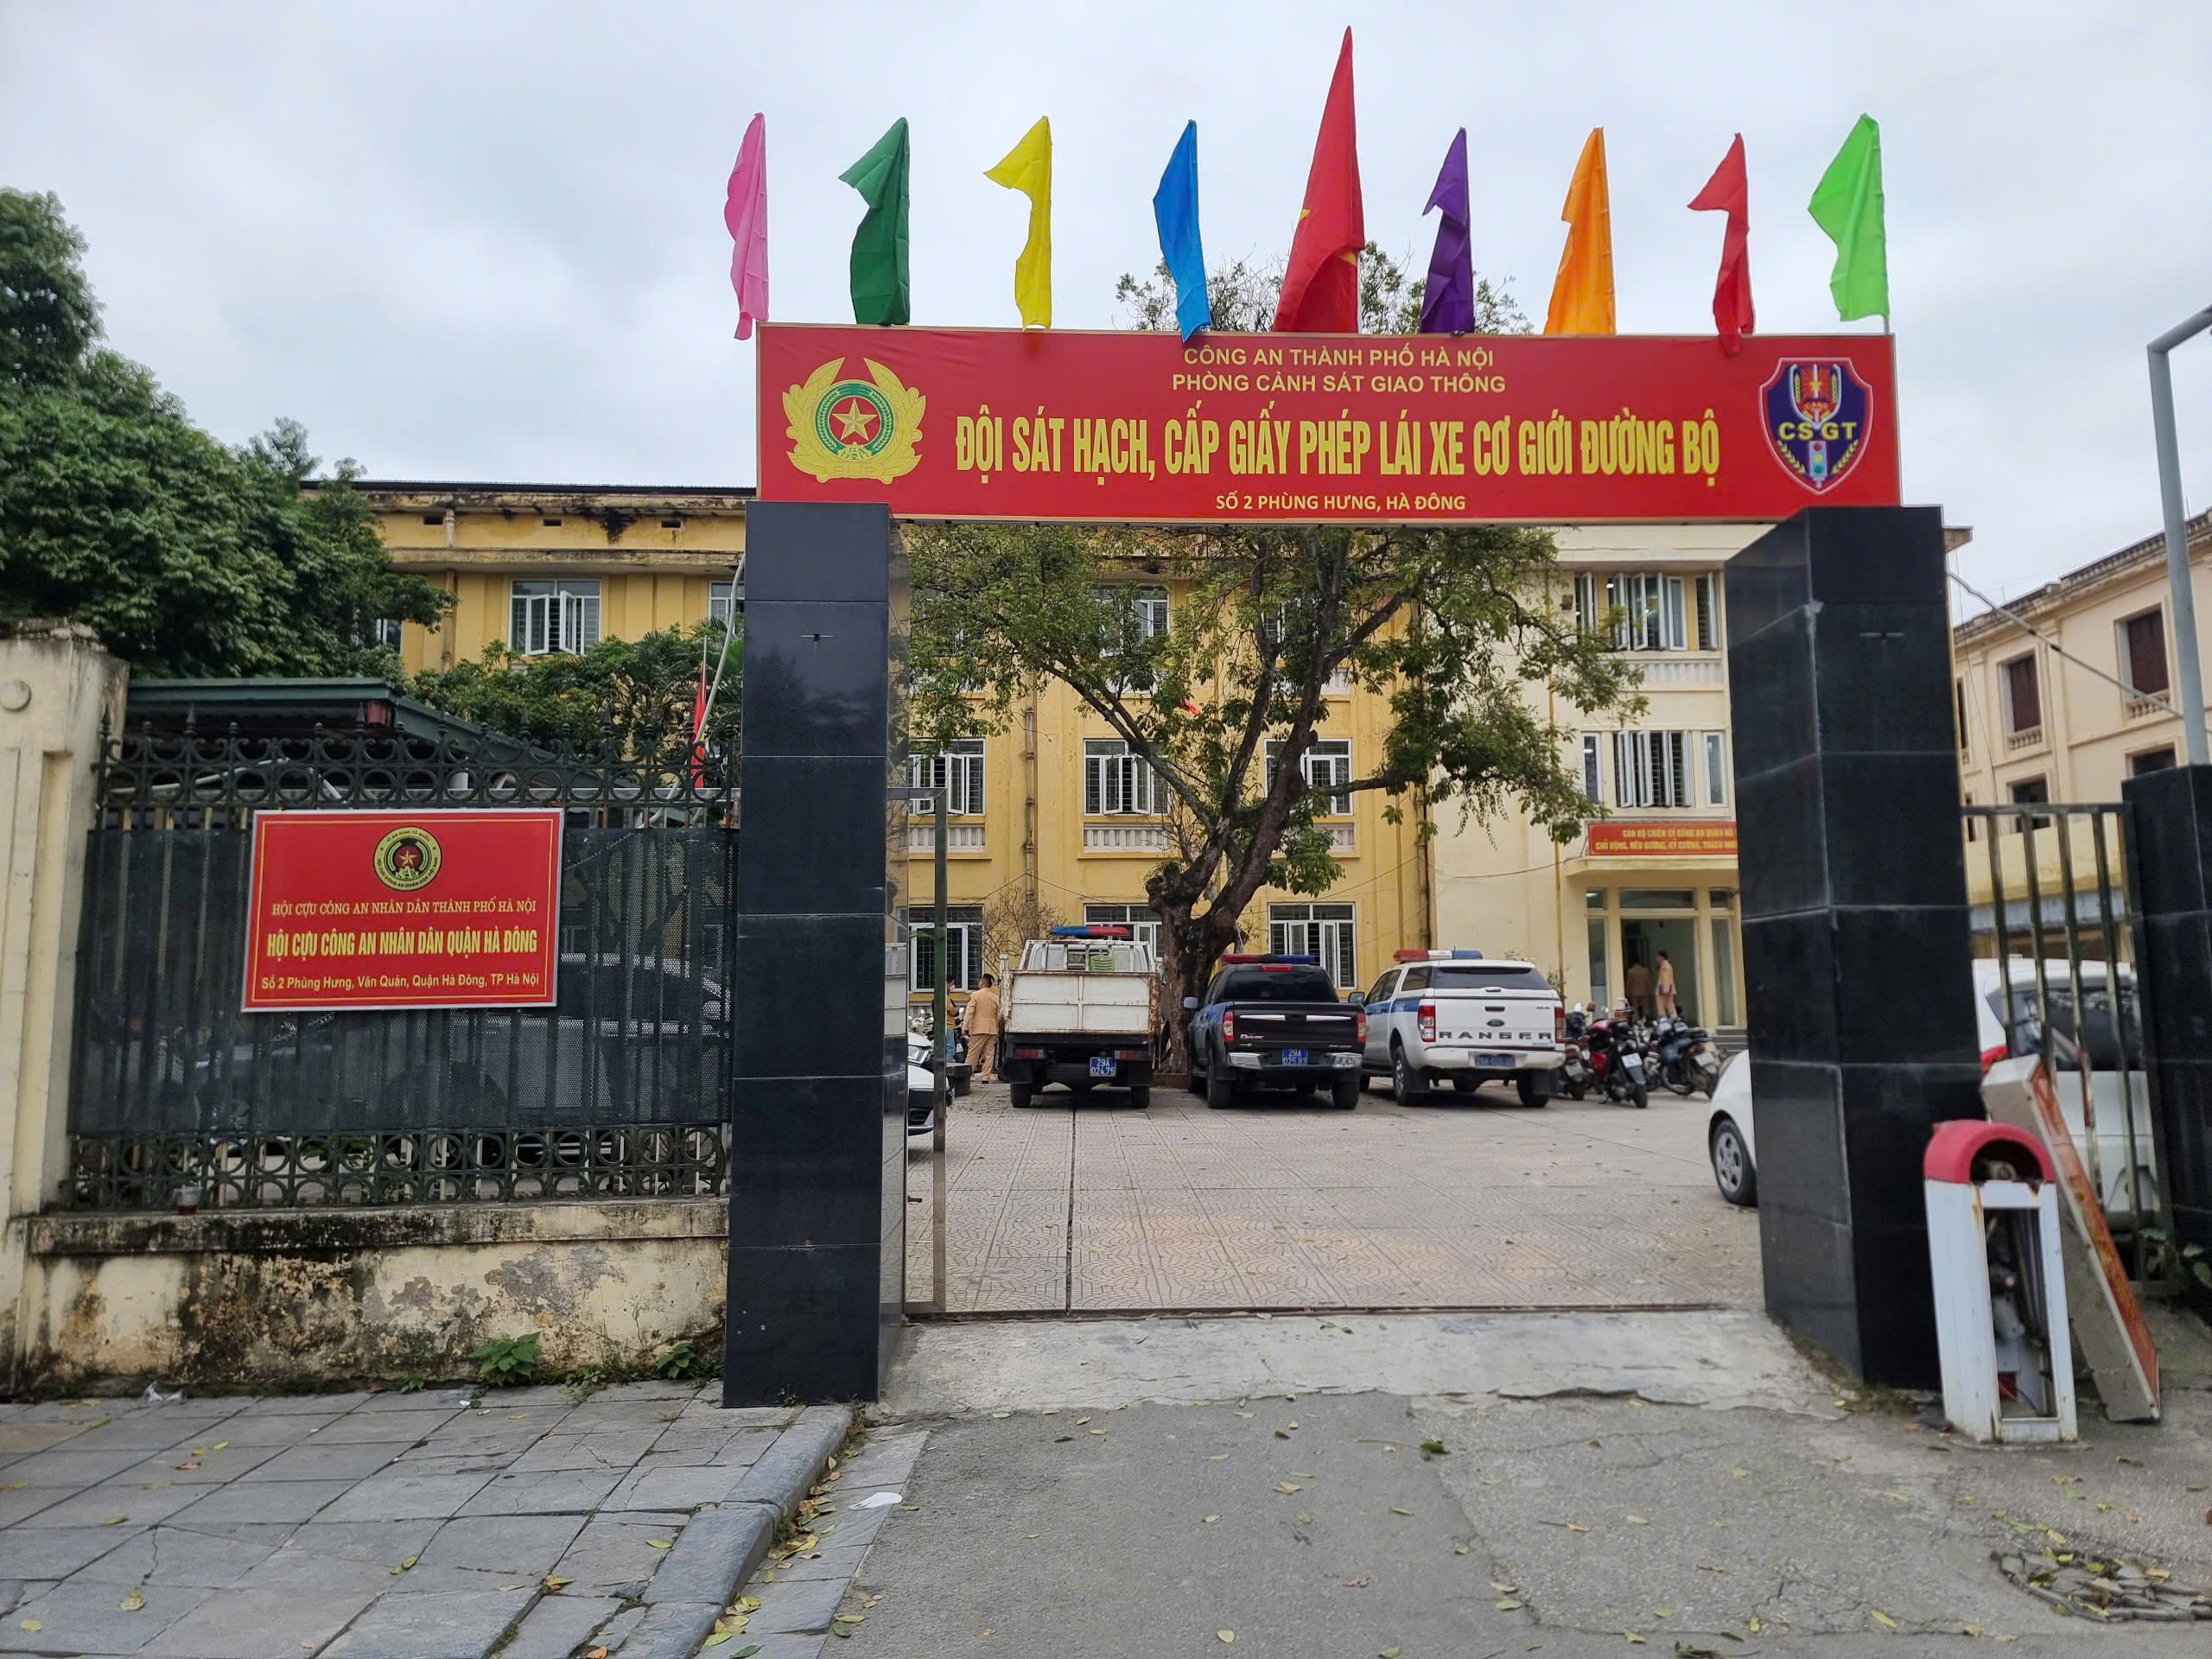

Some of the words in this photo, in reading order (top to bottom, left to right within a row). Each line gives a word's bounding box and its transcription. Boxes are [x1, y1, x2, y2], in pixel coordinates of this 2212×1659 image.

[1184, 344, 1247, 365] CÔNG
[1253, 348, 1283, 365] AN
[1289, 346, 1363, 366] THÀNH
[1370, 342, 1414, 367] PHỐ
[1421, 346, 1451, 367] HÀ
[1457, 346, 1494, 371] NỘI
[1173, 371, 1249, 391] PHÒNG
[1255, 371, 1316, 392] CẢNH
[1322, 372, 1365, 392] SÁT
[1370, 375, 1424, 393] GIAO
[1430, 372, 1506, 393] THÔNG
[955, 404, 1003, 484] ĐỘI
[1012, 406, 1065, 473] SÁT
[1073, 418, 1155, 486] HẠCH,
[1164, 400, 1220, 474] CẤP
[1229, 401, 1292, 475] GIẤY
[1300, 409, 1371, 475] PHÉP
[1379, 410, 1421, 475] LÁI
[1429, 421, 1465, 475] XE
[1473, 416, 1511, 476] CƠ
[1518, 409, 1573, 475] GIỚI
[1580, 408, 1675, 475] ĐƯỜNG
[1682, 408, 1719, 486] BỘ
[1216, 490, 1239, 510] SỐ
[1243, 495, 1253, 510] 2
[1258, 492, 1319, 510] PHÙNG
[1324, 494, 1382, 512] HƯNG,
[1386, 492, 1411, 510] HÀ
[1414, 492, 1466, 511] ĐÔNG
[271, 900, 293, 918] HỘI
[295, 902, 318, 918] CỰU
[320, 899, 350, 915] CÔNG
[353, 902, 370, 914] AN
[372, 899, 404, 914] NHÂN
[407, 899, 430, 913] DÂN
[433, 899, 471, 913] THÀNH
[474, 895, 496, 913] PHỐ
[499, 898, 514, 912] HÀ
[517, 898, 537, 914] NỘI
[267, 928, 289, 962] HỘI
[292, 930, 318, 962] CỰU
[321, 927, 356, 957] CÔNG
[359, 931, 377, 955] AN
[379, 926, 415, 955] NHÂN
[417, 926, 444, 955] DÂN
[447, 925, 481, 959] QUẬN
[484, 925, 500, 953] HÀ
[504, 925, 537, 953] ĐÔNG
[262, 974, 276, 989] Số
[278, 978, 284, 989] 2
[287, 976, 321, 991] Phùng
[323, 976, 354, 991] Hưng,
[358, 976, 377, 988] Văn
[412, 974, 439, 988] Quận
[442, 974, 455, 986] Hà
[458, 974, 487, 988] Đông,
[491, 974, 504, 985] TP
[506, 973, 519, 985] Hà
[523, 973, 539, 987] Nội
[1439, 1031, 1552, 1039] RANGER
[1288, 1049, 1302, 1058] 29A
